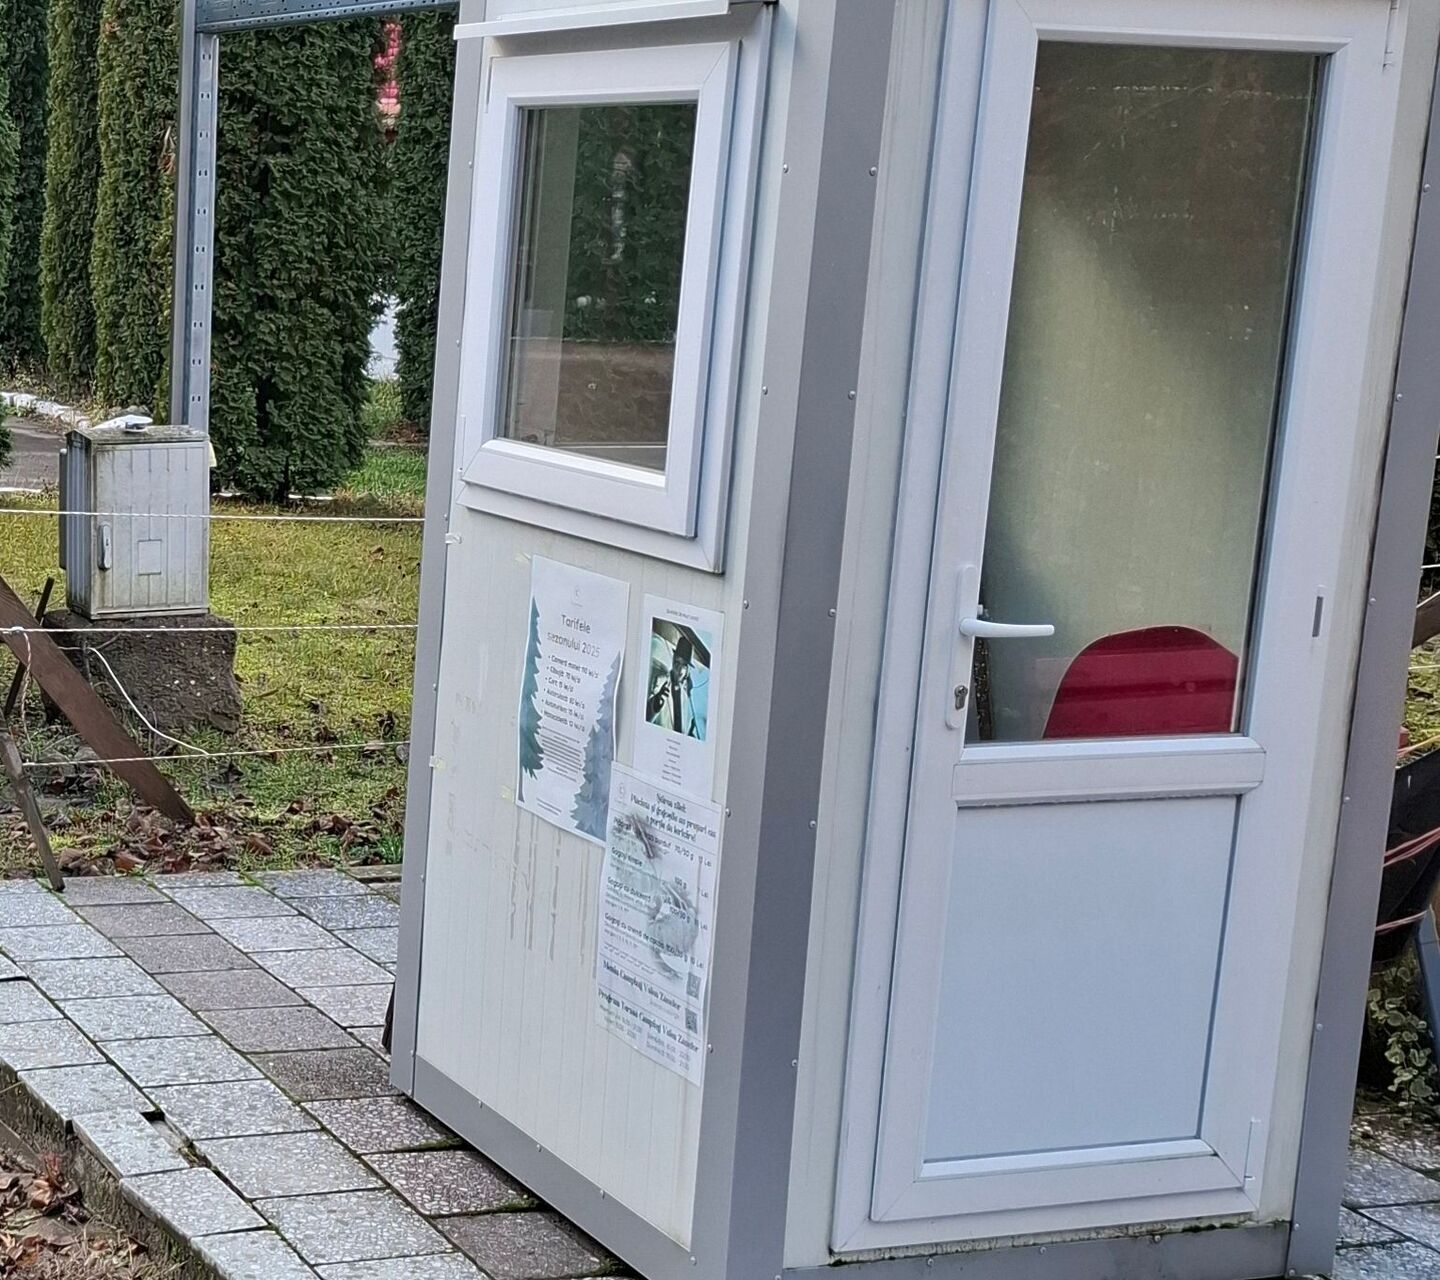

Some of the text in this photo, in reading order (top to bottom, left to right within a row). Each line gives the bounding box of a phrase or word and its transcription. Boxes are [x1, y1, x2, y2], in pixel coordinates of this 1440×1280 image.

[561, 614, 591, 634] Tarifele
[546, 632, 600, 658] sezonului 2025
